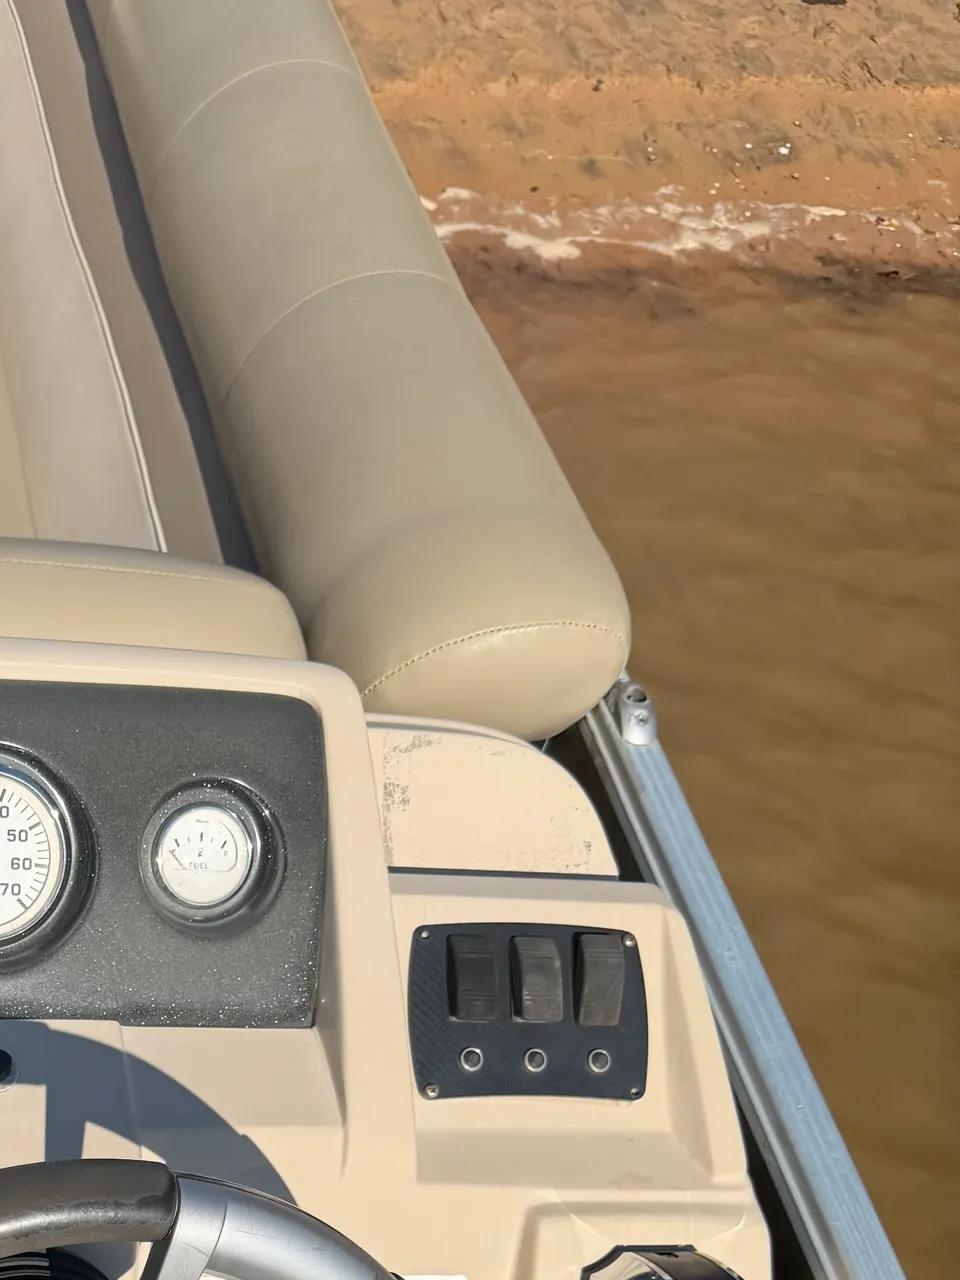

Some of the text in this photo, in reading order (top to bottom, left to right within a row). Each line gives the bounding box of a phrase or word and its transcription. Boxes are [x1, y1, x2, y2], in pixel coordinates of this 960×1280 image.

[7, 829, 28, 843] 50
[11, 857, 33, 871] 60
[189, 861, 209, 870] FUEL
[0, 882, 21, 896] 70
